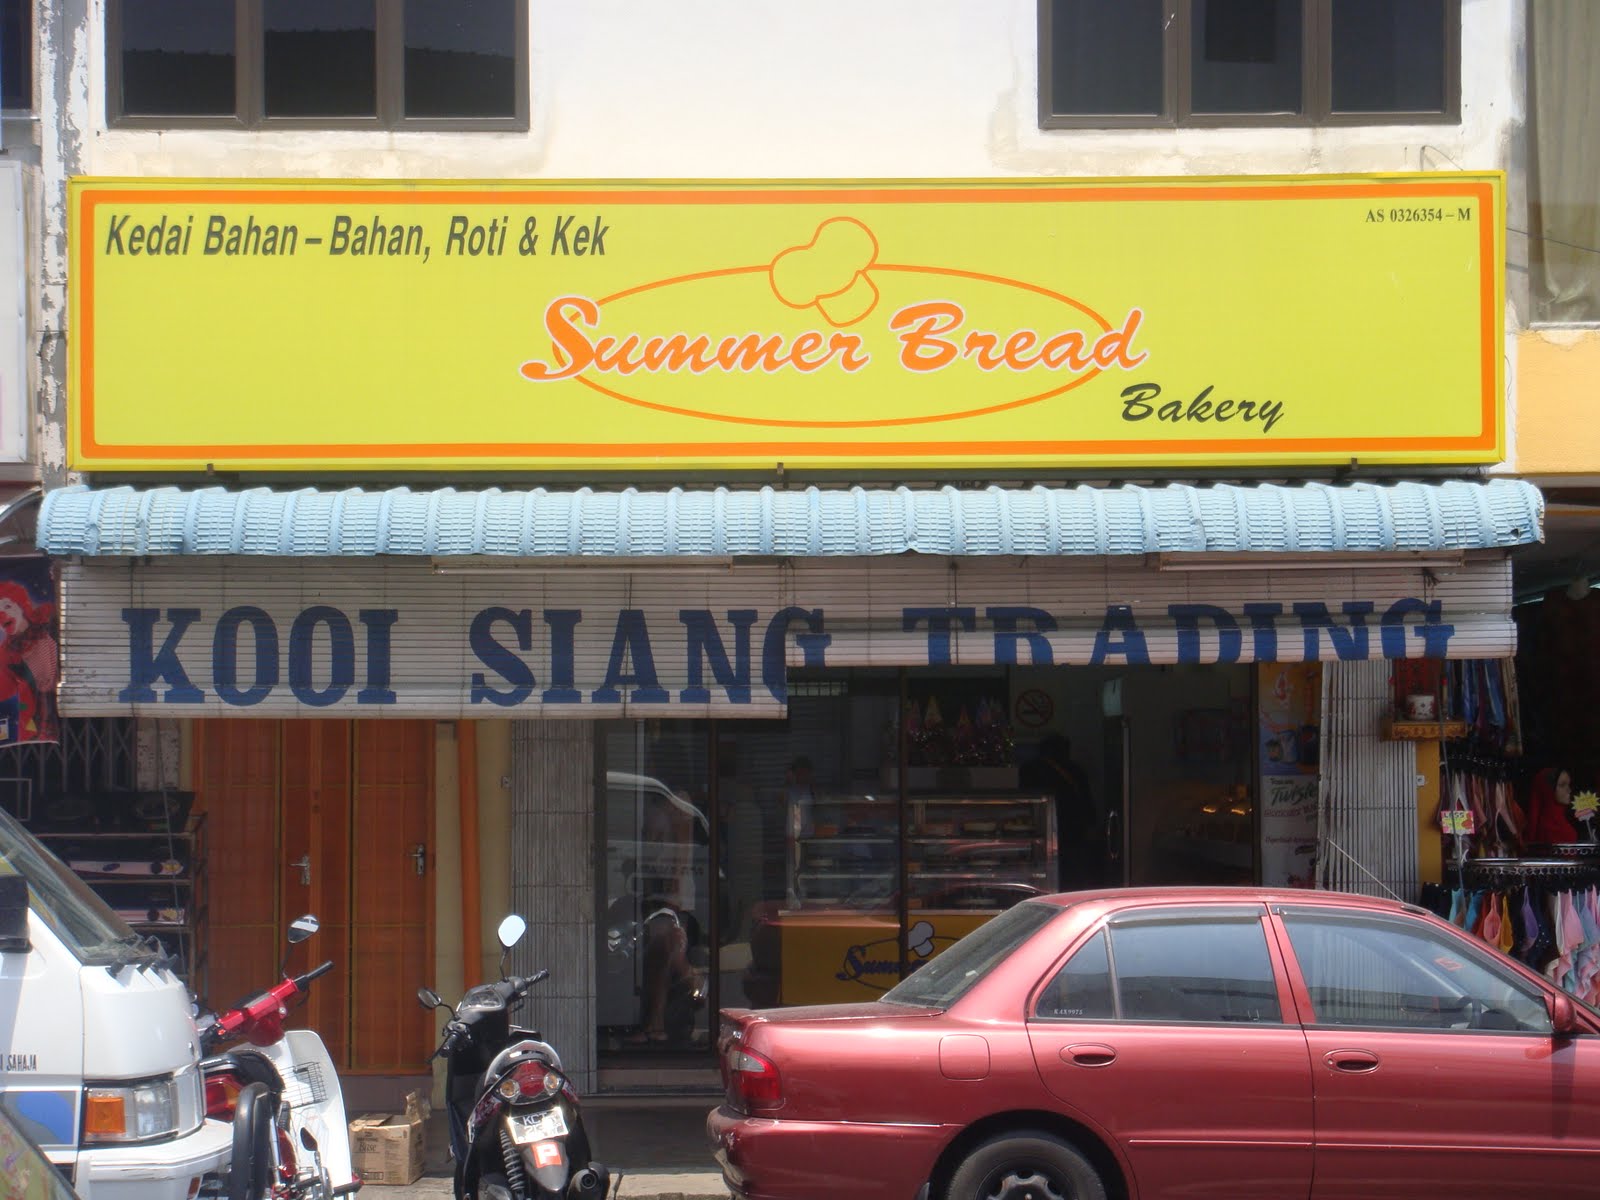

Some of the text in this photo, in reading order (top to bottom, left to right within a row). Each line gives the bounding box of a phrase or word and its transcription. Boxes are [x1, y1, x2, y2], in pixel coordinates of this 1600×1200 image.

[1365, 208, 1386, 223] AS
[1390, 207, 1443, 223] 0326354
[105, 215, 194, 257] Kedai
[203, 215, 298, 257] Bahan
[328, 215, 431, 265] Bahan,
[445, 215, 509, 257] Roti
[518, 215, 539, 257] &
[550, 215, 609, 256] Kek
[519, 295, 1150, 382] Summer Bread
[1120, 382, 1285, 434] Bakery
[119, 597, 1456, 707] KOOI SIANG TRADING
[6, 1053, 38, 1072] SAHAJA
[522, 1111, 548, 1127] KCT
[535, 1143, 559, 1166] P
